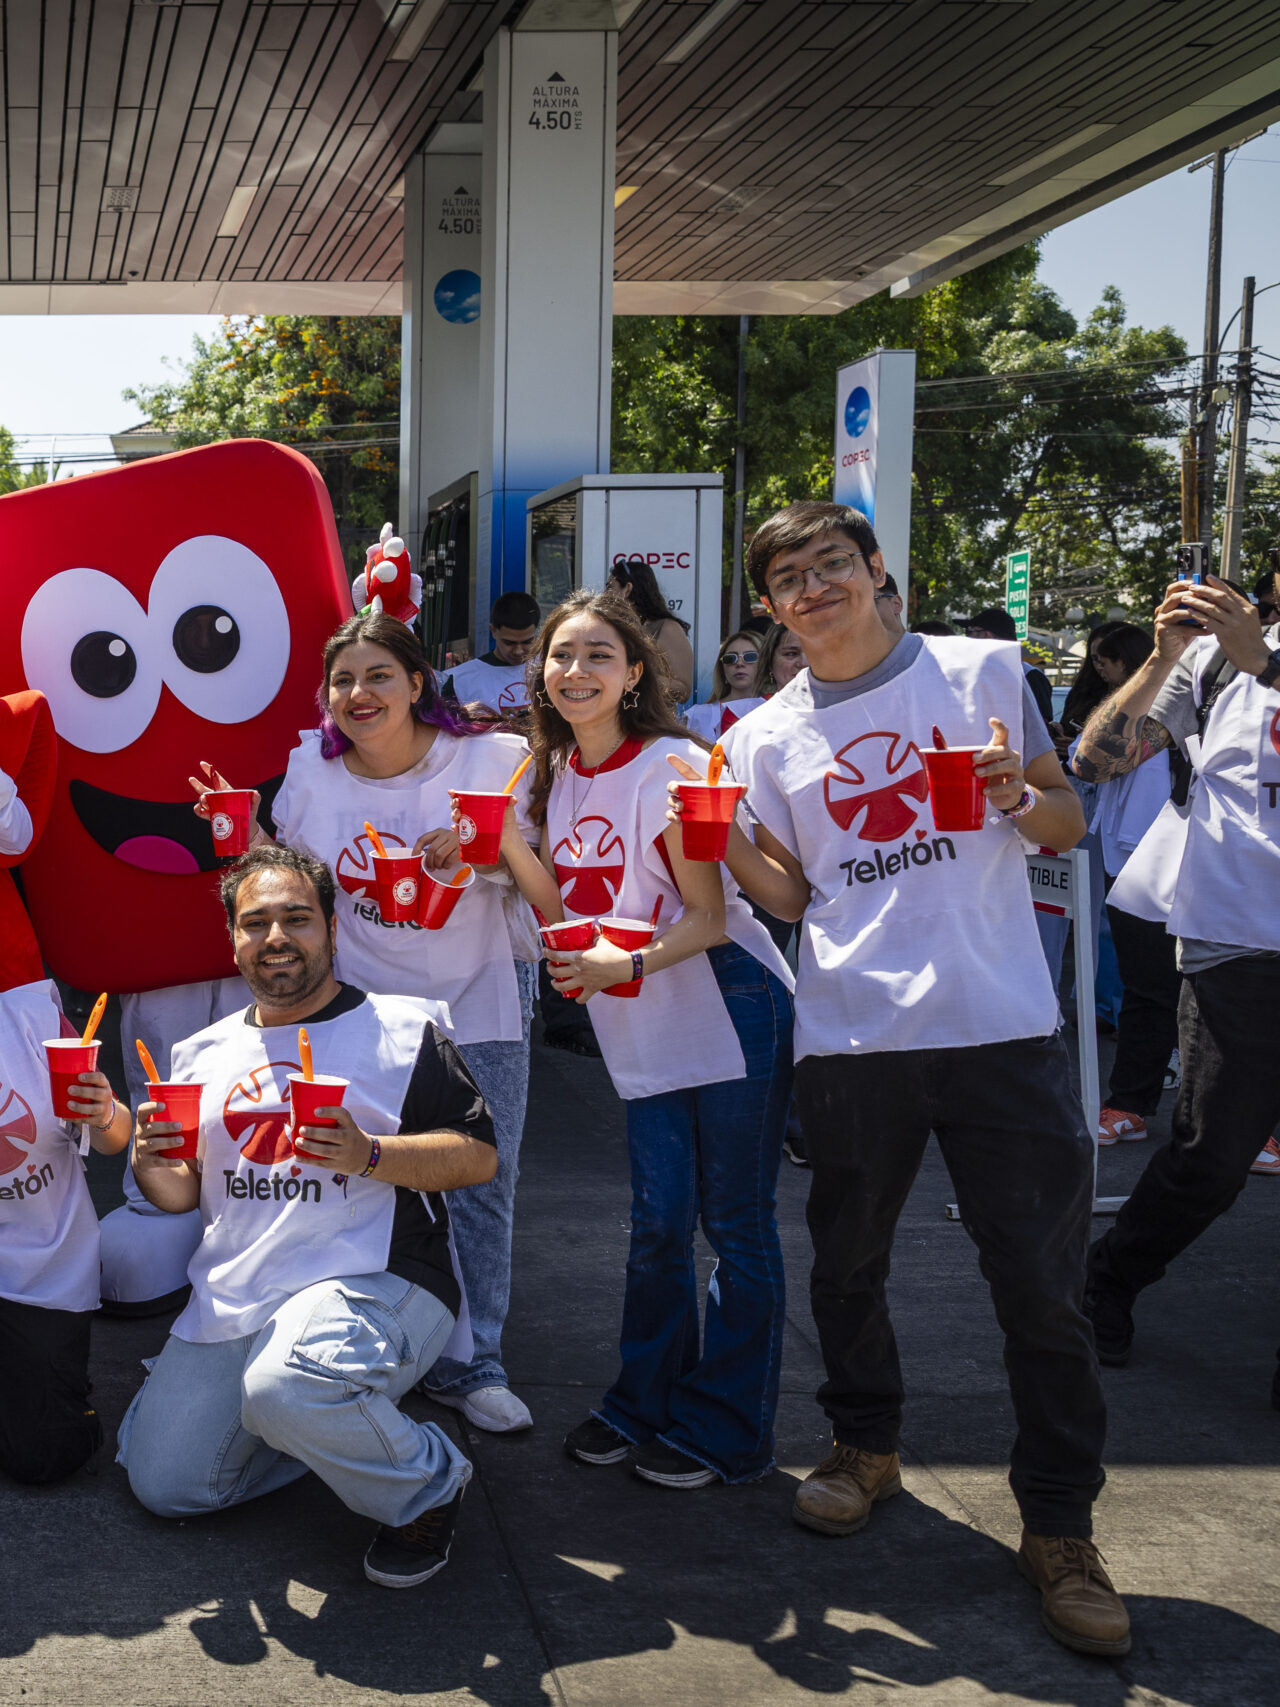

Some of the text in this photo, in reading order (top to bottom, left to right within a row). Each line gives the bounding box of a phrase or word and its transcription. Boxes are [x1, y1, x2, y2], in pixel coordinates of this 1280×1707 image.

[533, 86, 579, 96] ALTURA
[533, 97, 578, 108] MÁXIMA
[528, 110, 571, 130] 4.50
[442, 198, 480, 206] ALTURA
[438, 218, 474, 234] 4.50
[842, 449, 870, 467] COPEC
[839, 828, 956, 887] Teletón
[1027, 865, 1069, 890] TIBLE
[223, 1165, 322, 1203] Teletón
